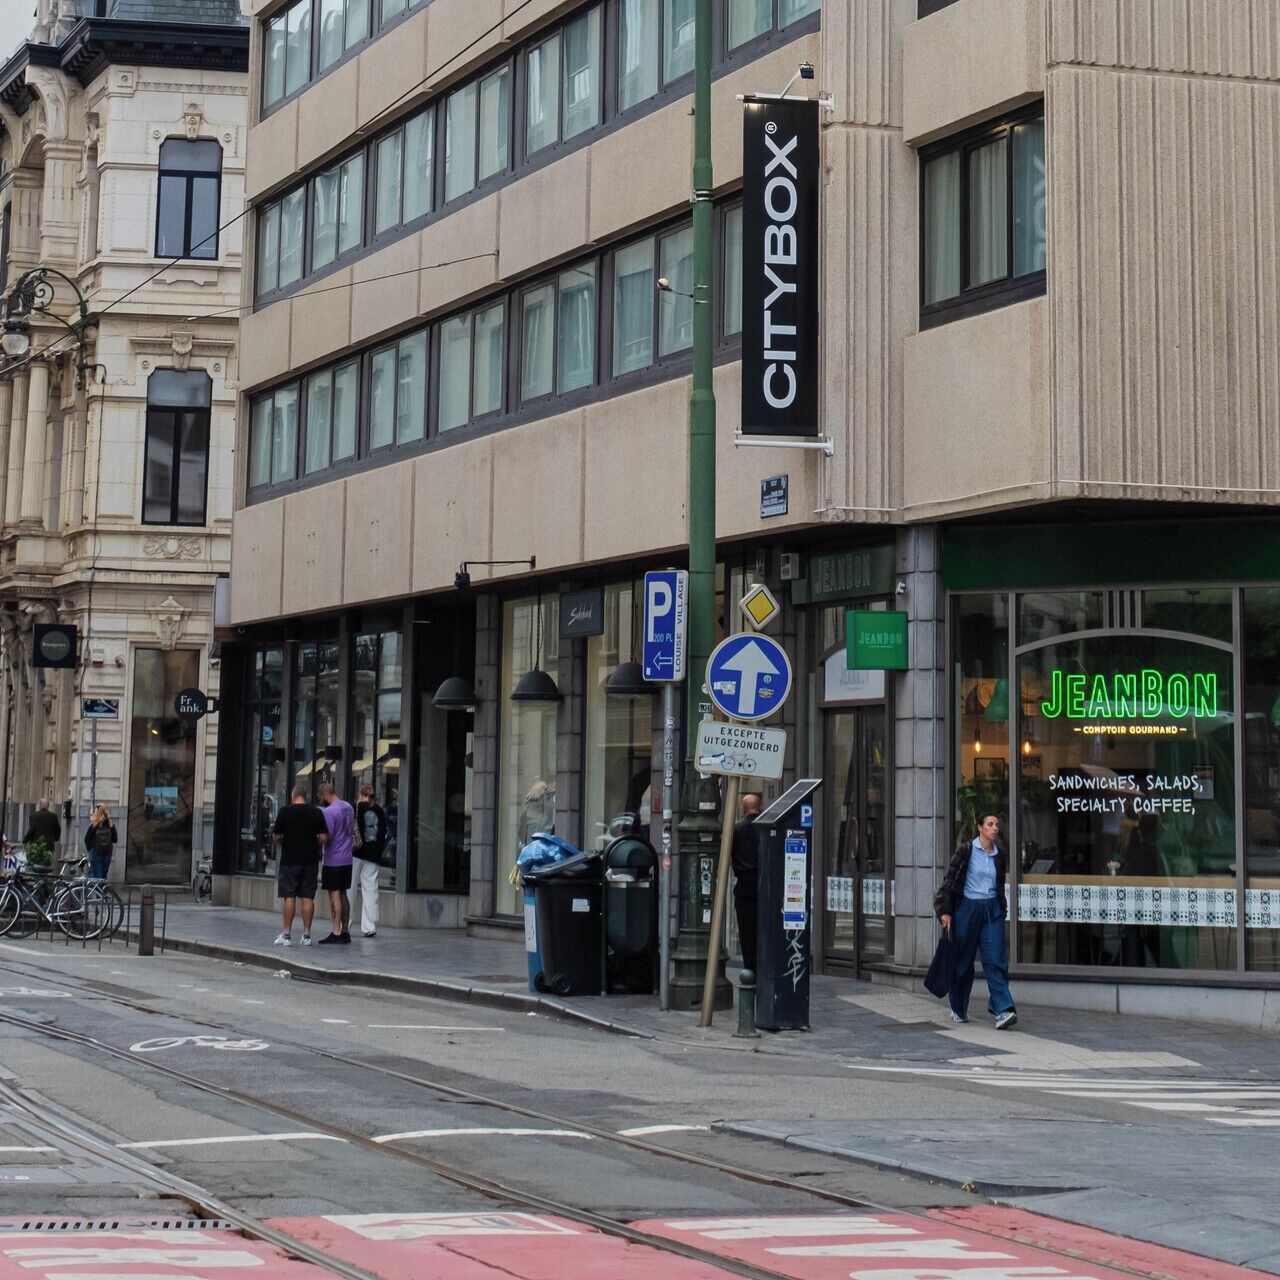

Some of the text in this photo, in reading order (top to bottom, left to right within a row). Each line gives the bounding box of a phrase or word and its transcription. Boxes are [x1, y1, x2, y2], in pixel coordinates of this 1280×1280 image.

[648, 581, 672, 642] P
[666, 633, 673, 642] PL
[675, 632, 683, 673] LOUISE
[180, 696, 192, 705] Fr
[1041, 669, 1218, 718] JEANBON
[180, 704, 203, 713] ank.
[720, 726, 766, 740] EXCEPTE
[1083, 725, 1178, 734] COMPTOIR GOURMAND
[704, 736, 779, 753] UITGEZONDERD
[1049, 774, 1204, 793] SANDWICHES, SALADS,
[1056, 796, 1196, 815] SPECIALTY COFFEE,
